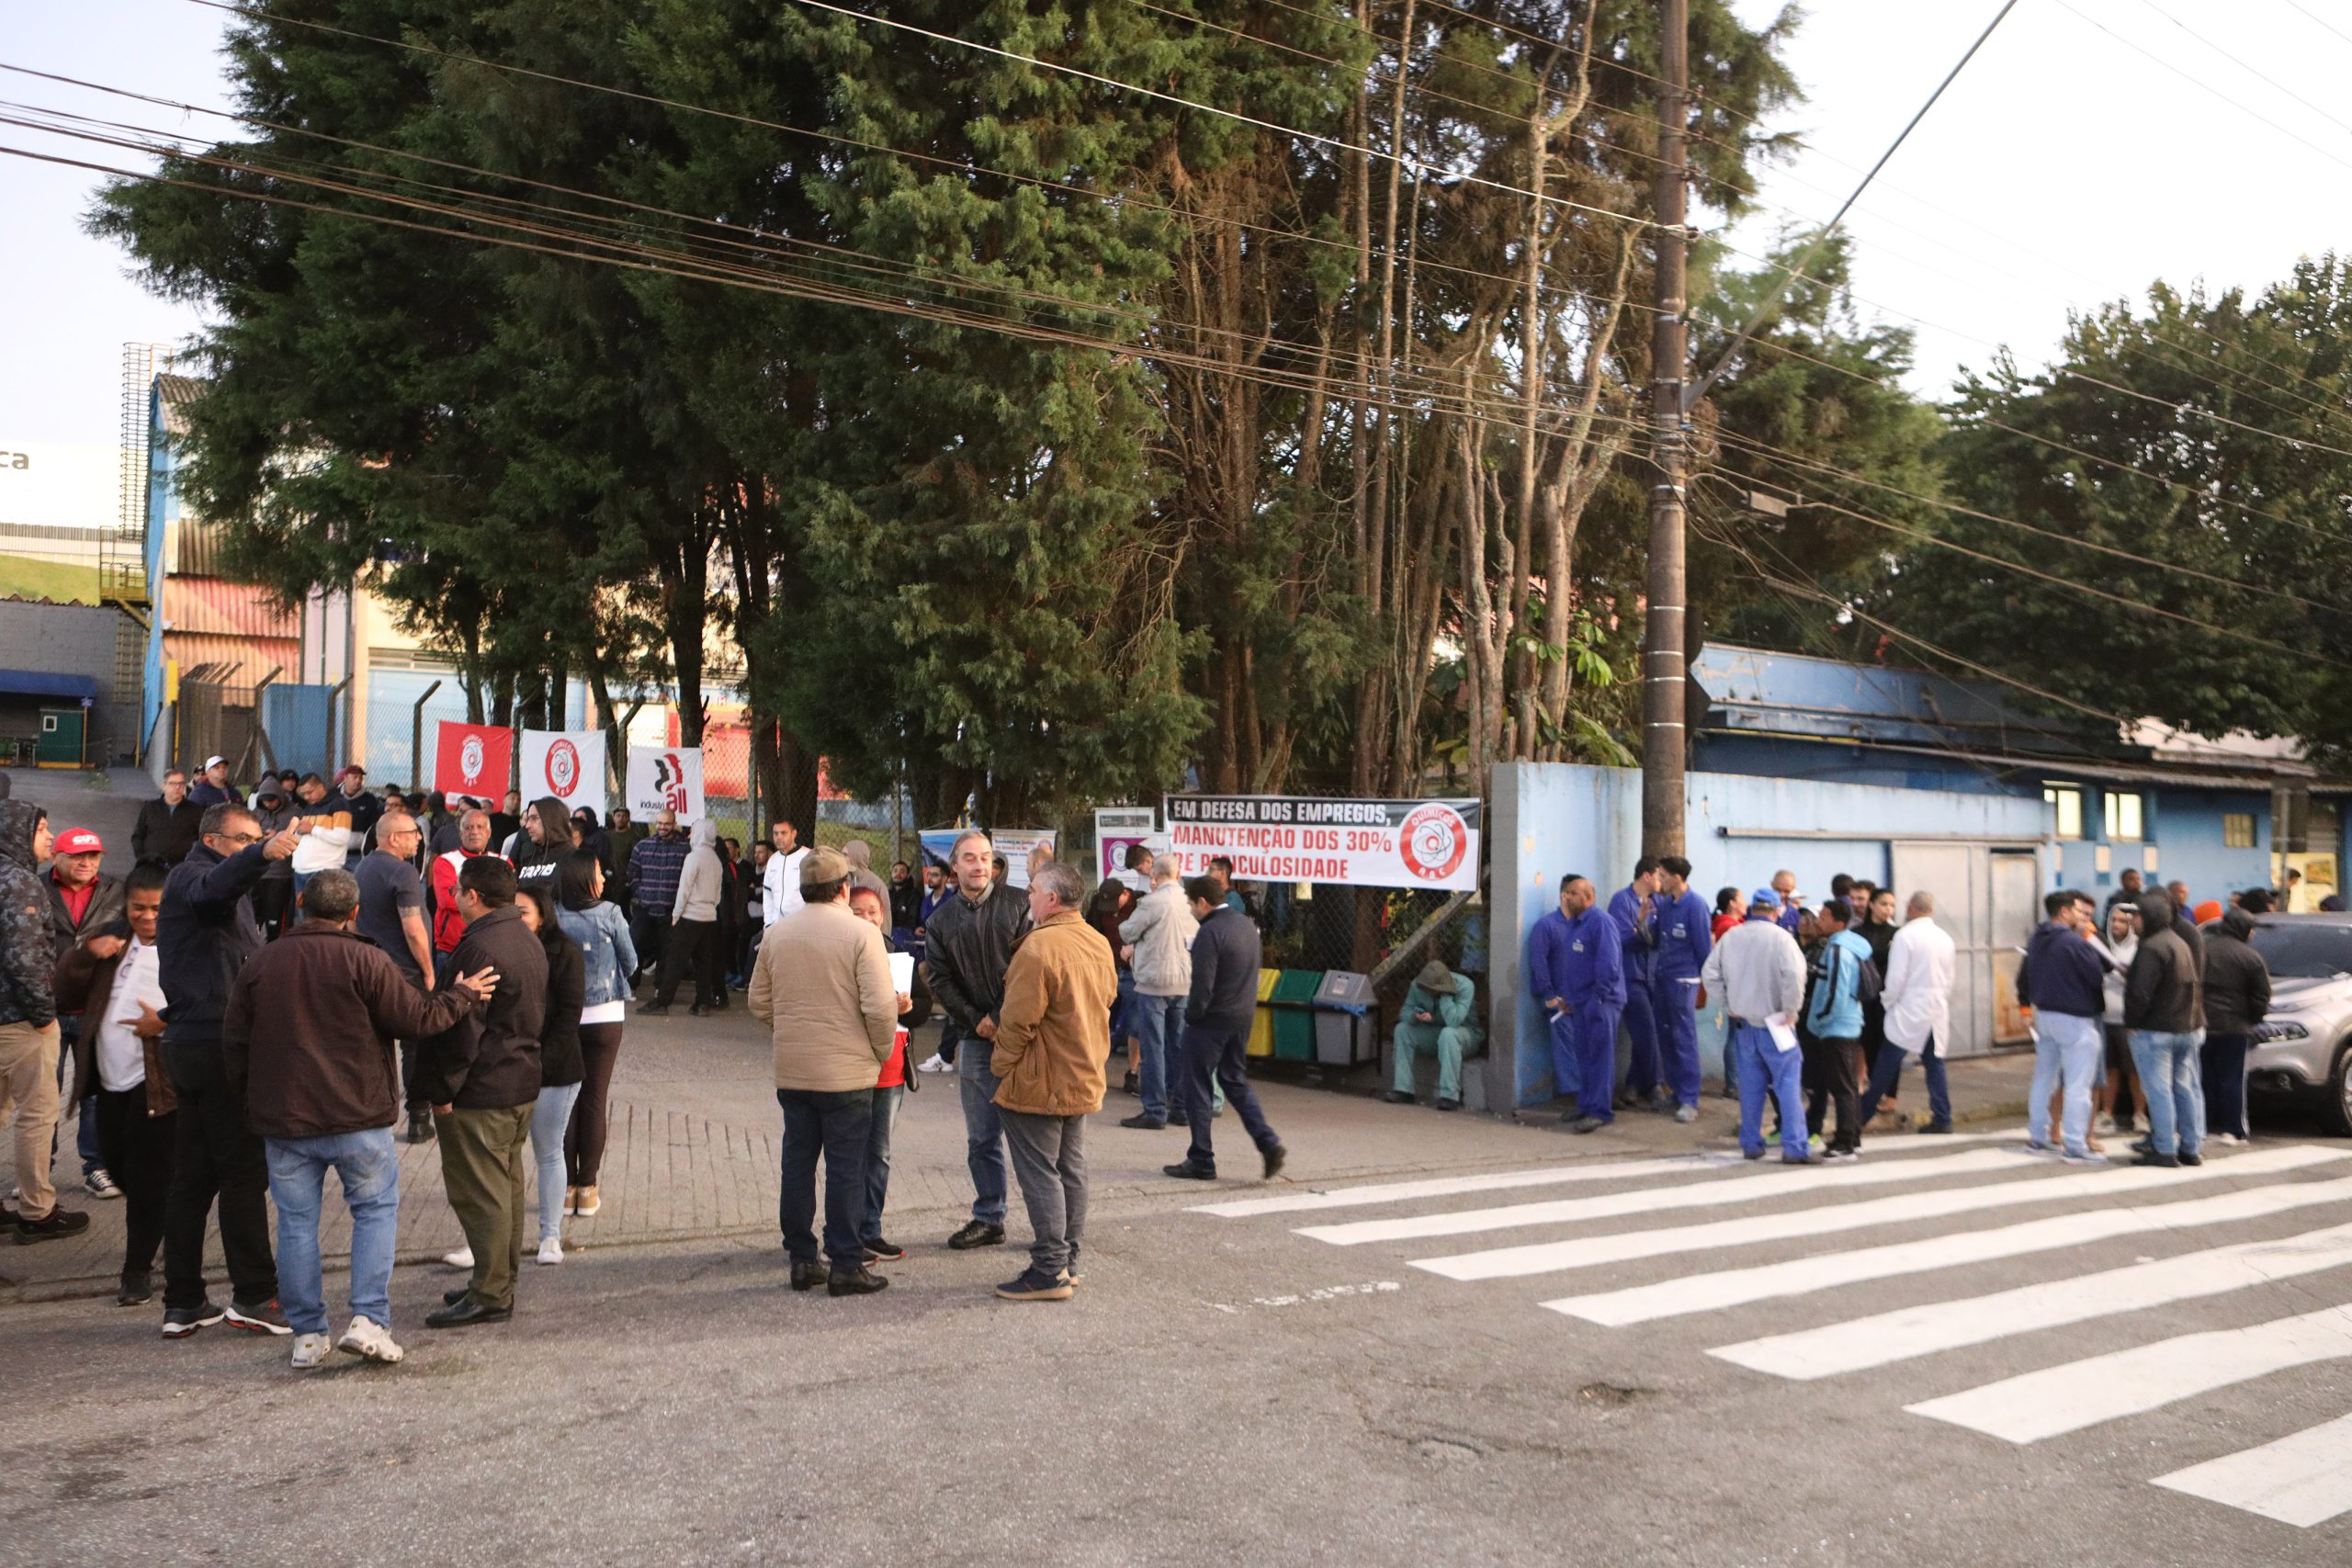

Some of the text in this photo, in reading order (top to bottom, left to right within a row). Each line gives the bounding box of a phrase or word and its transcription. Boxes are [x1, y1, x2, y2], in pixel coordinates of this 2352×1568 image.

[1174, 800, 1391, 826] EM DEFESA DOS EMPREGOS,
[1173, 823, 1392, 853] MANUTENÇÃO DOS 30%
[1200, 852, 1348, 879] PICULOSIDADE
